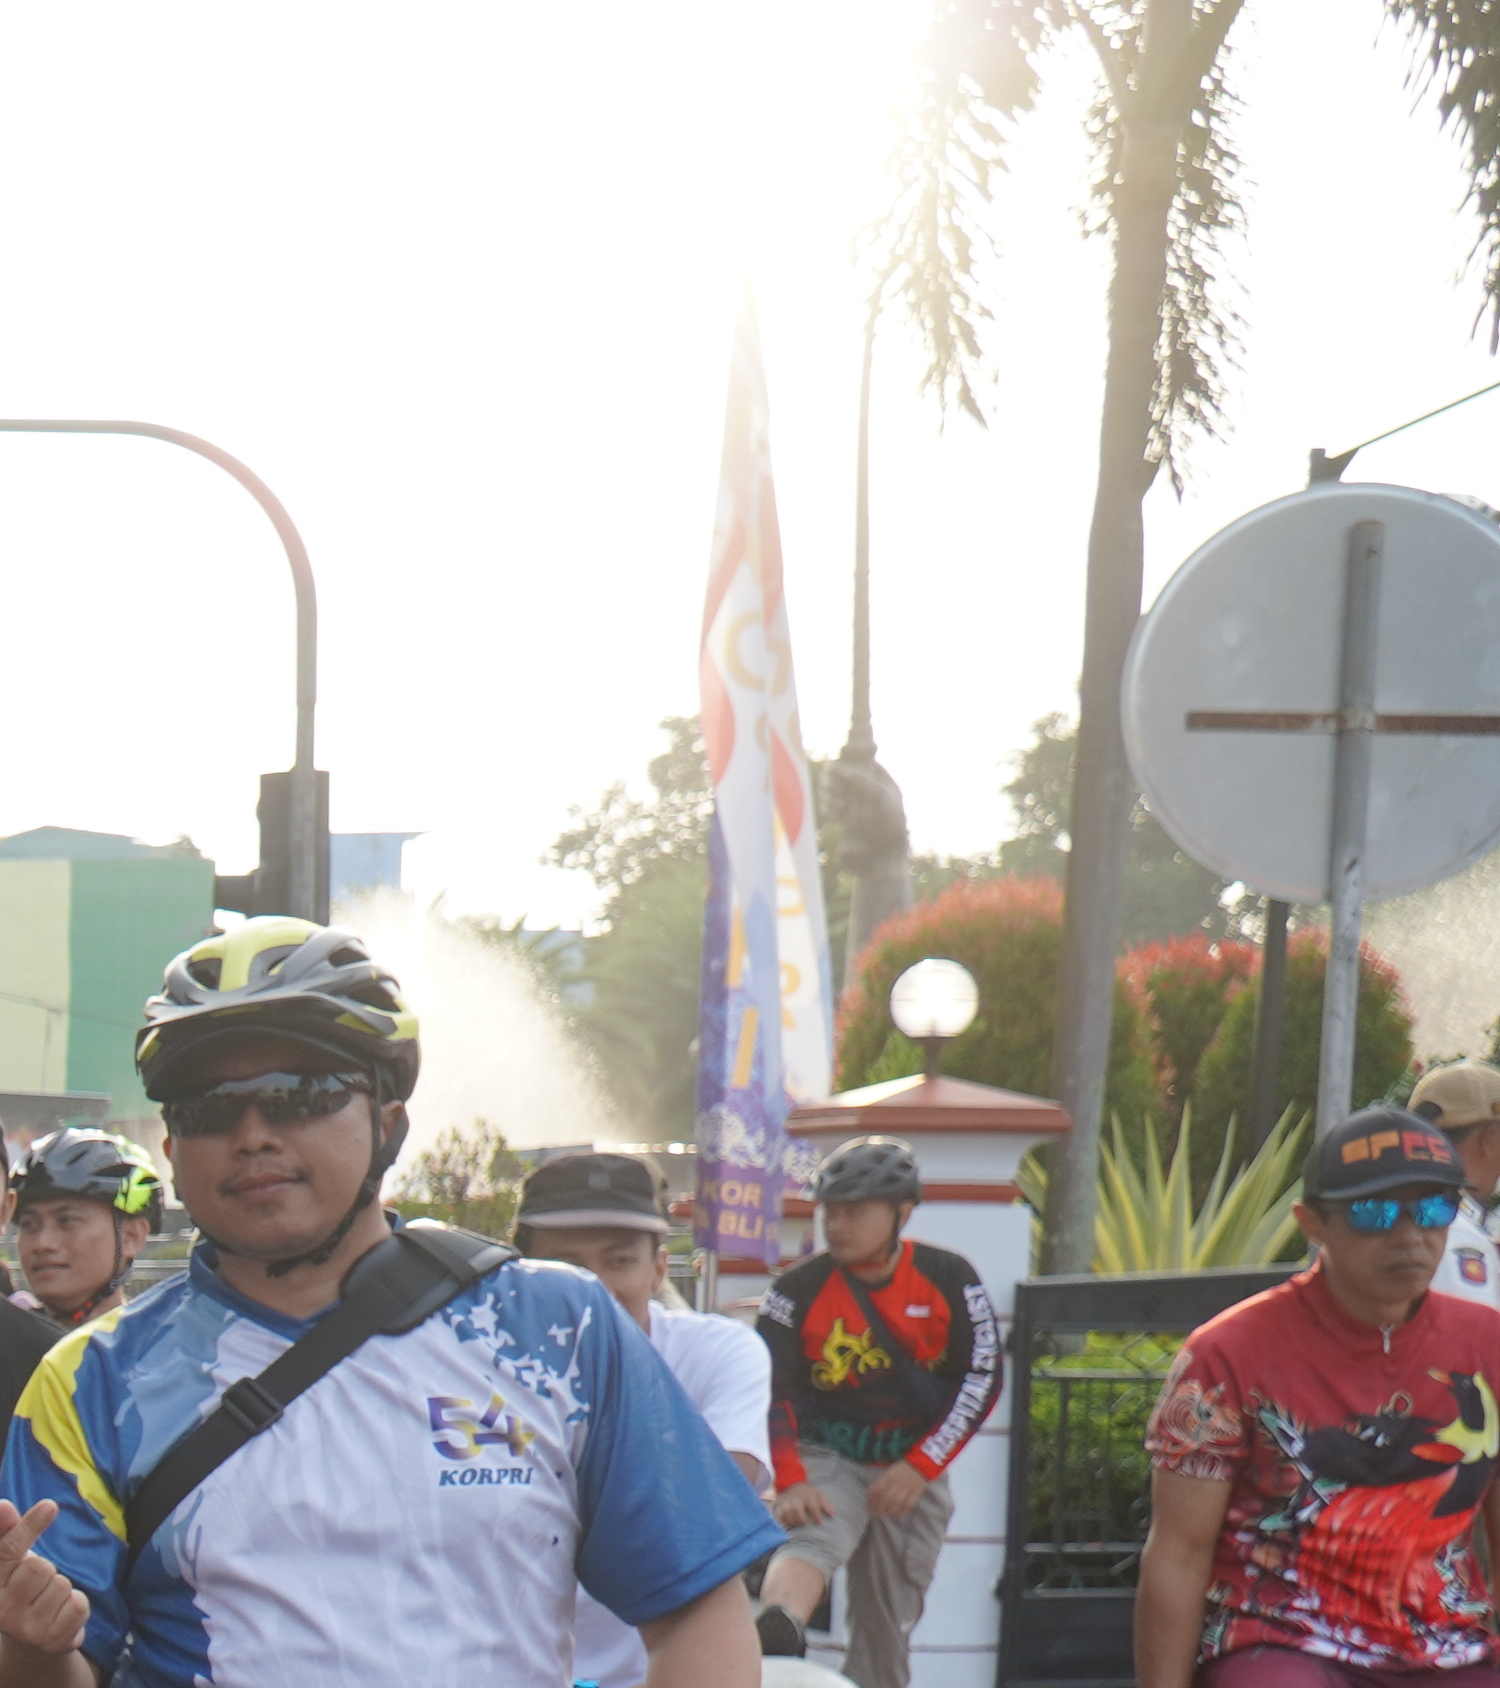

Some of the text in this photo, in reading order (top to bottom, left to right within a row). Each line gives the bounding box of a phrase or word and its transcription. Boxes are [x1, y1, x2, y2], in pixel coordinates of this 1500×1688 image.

[426, 1393, 534, 1461] 54
[921, 1372, 993, 1467] HOSPITAL
[438, 1467, 534, 1487] KORPRI
